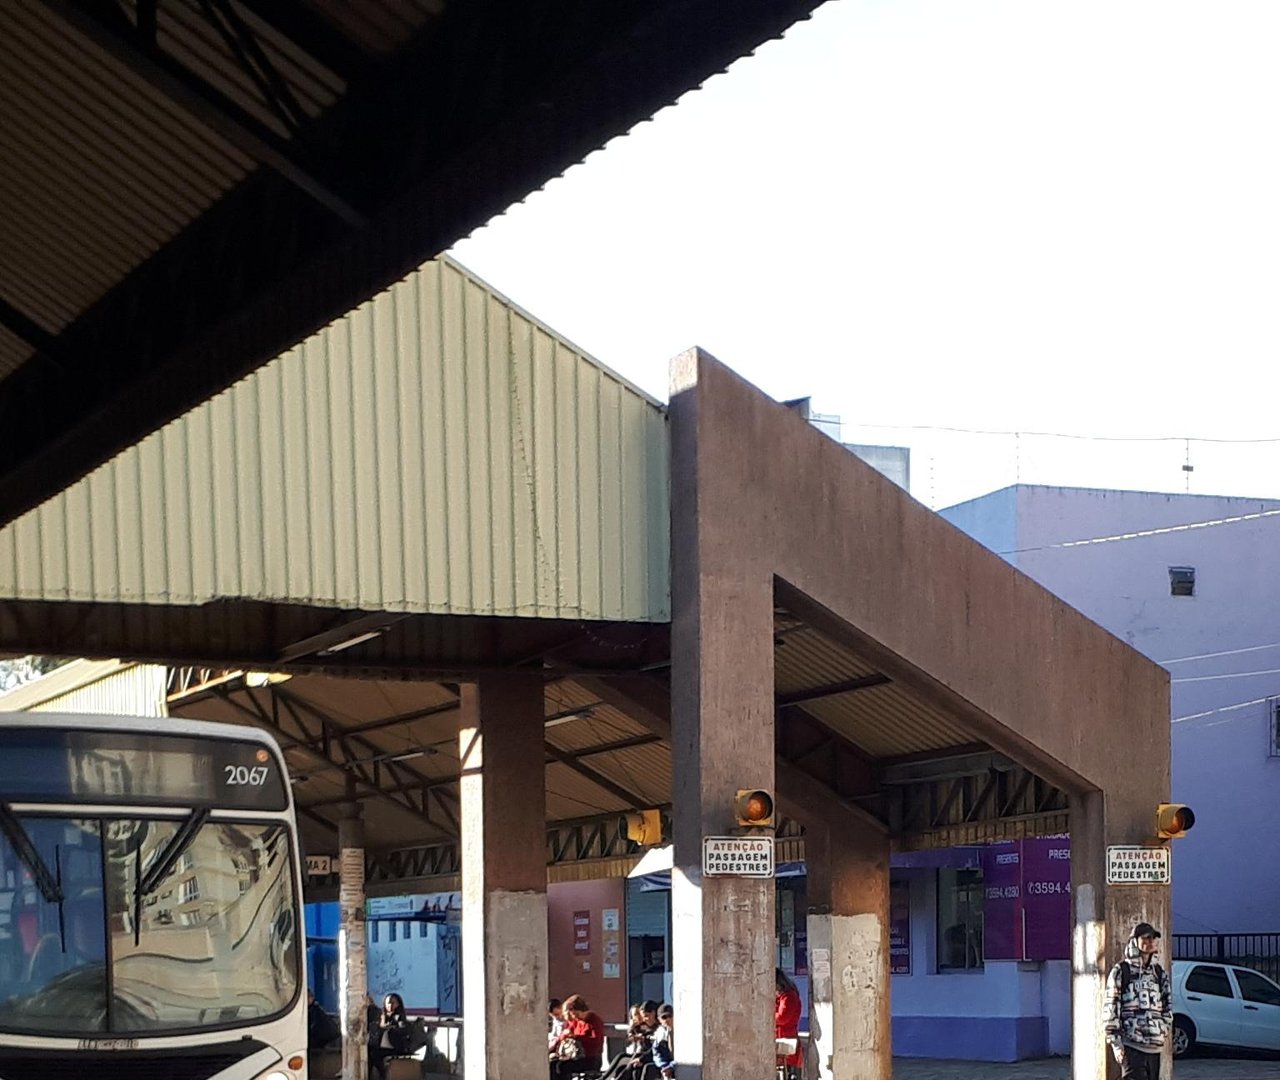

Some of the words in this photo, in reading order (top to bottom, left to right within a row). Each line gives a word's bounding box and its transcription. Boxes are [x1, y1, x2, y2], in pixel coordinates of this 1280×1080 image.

[224, 765, 269, 786] 2067
[713, 841, 764, 853] ATENÇÃO
[708, 853, 768, 862] PASSAGEM
[1115, 850, 1162, 861] ATENÇÃO
[321, 860, 328, 871] 2
[708, 863, 768, 872] PEDESTRES
[1111, 861, 1166, 870] PASSAGEM
